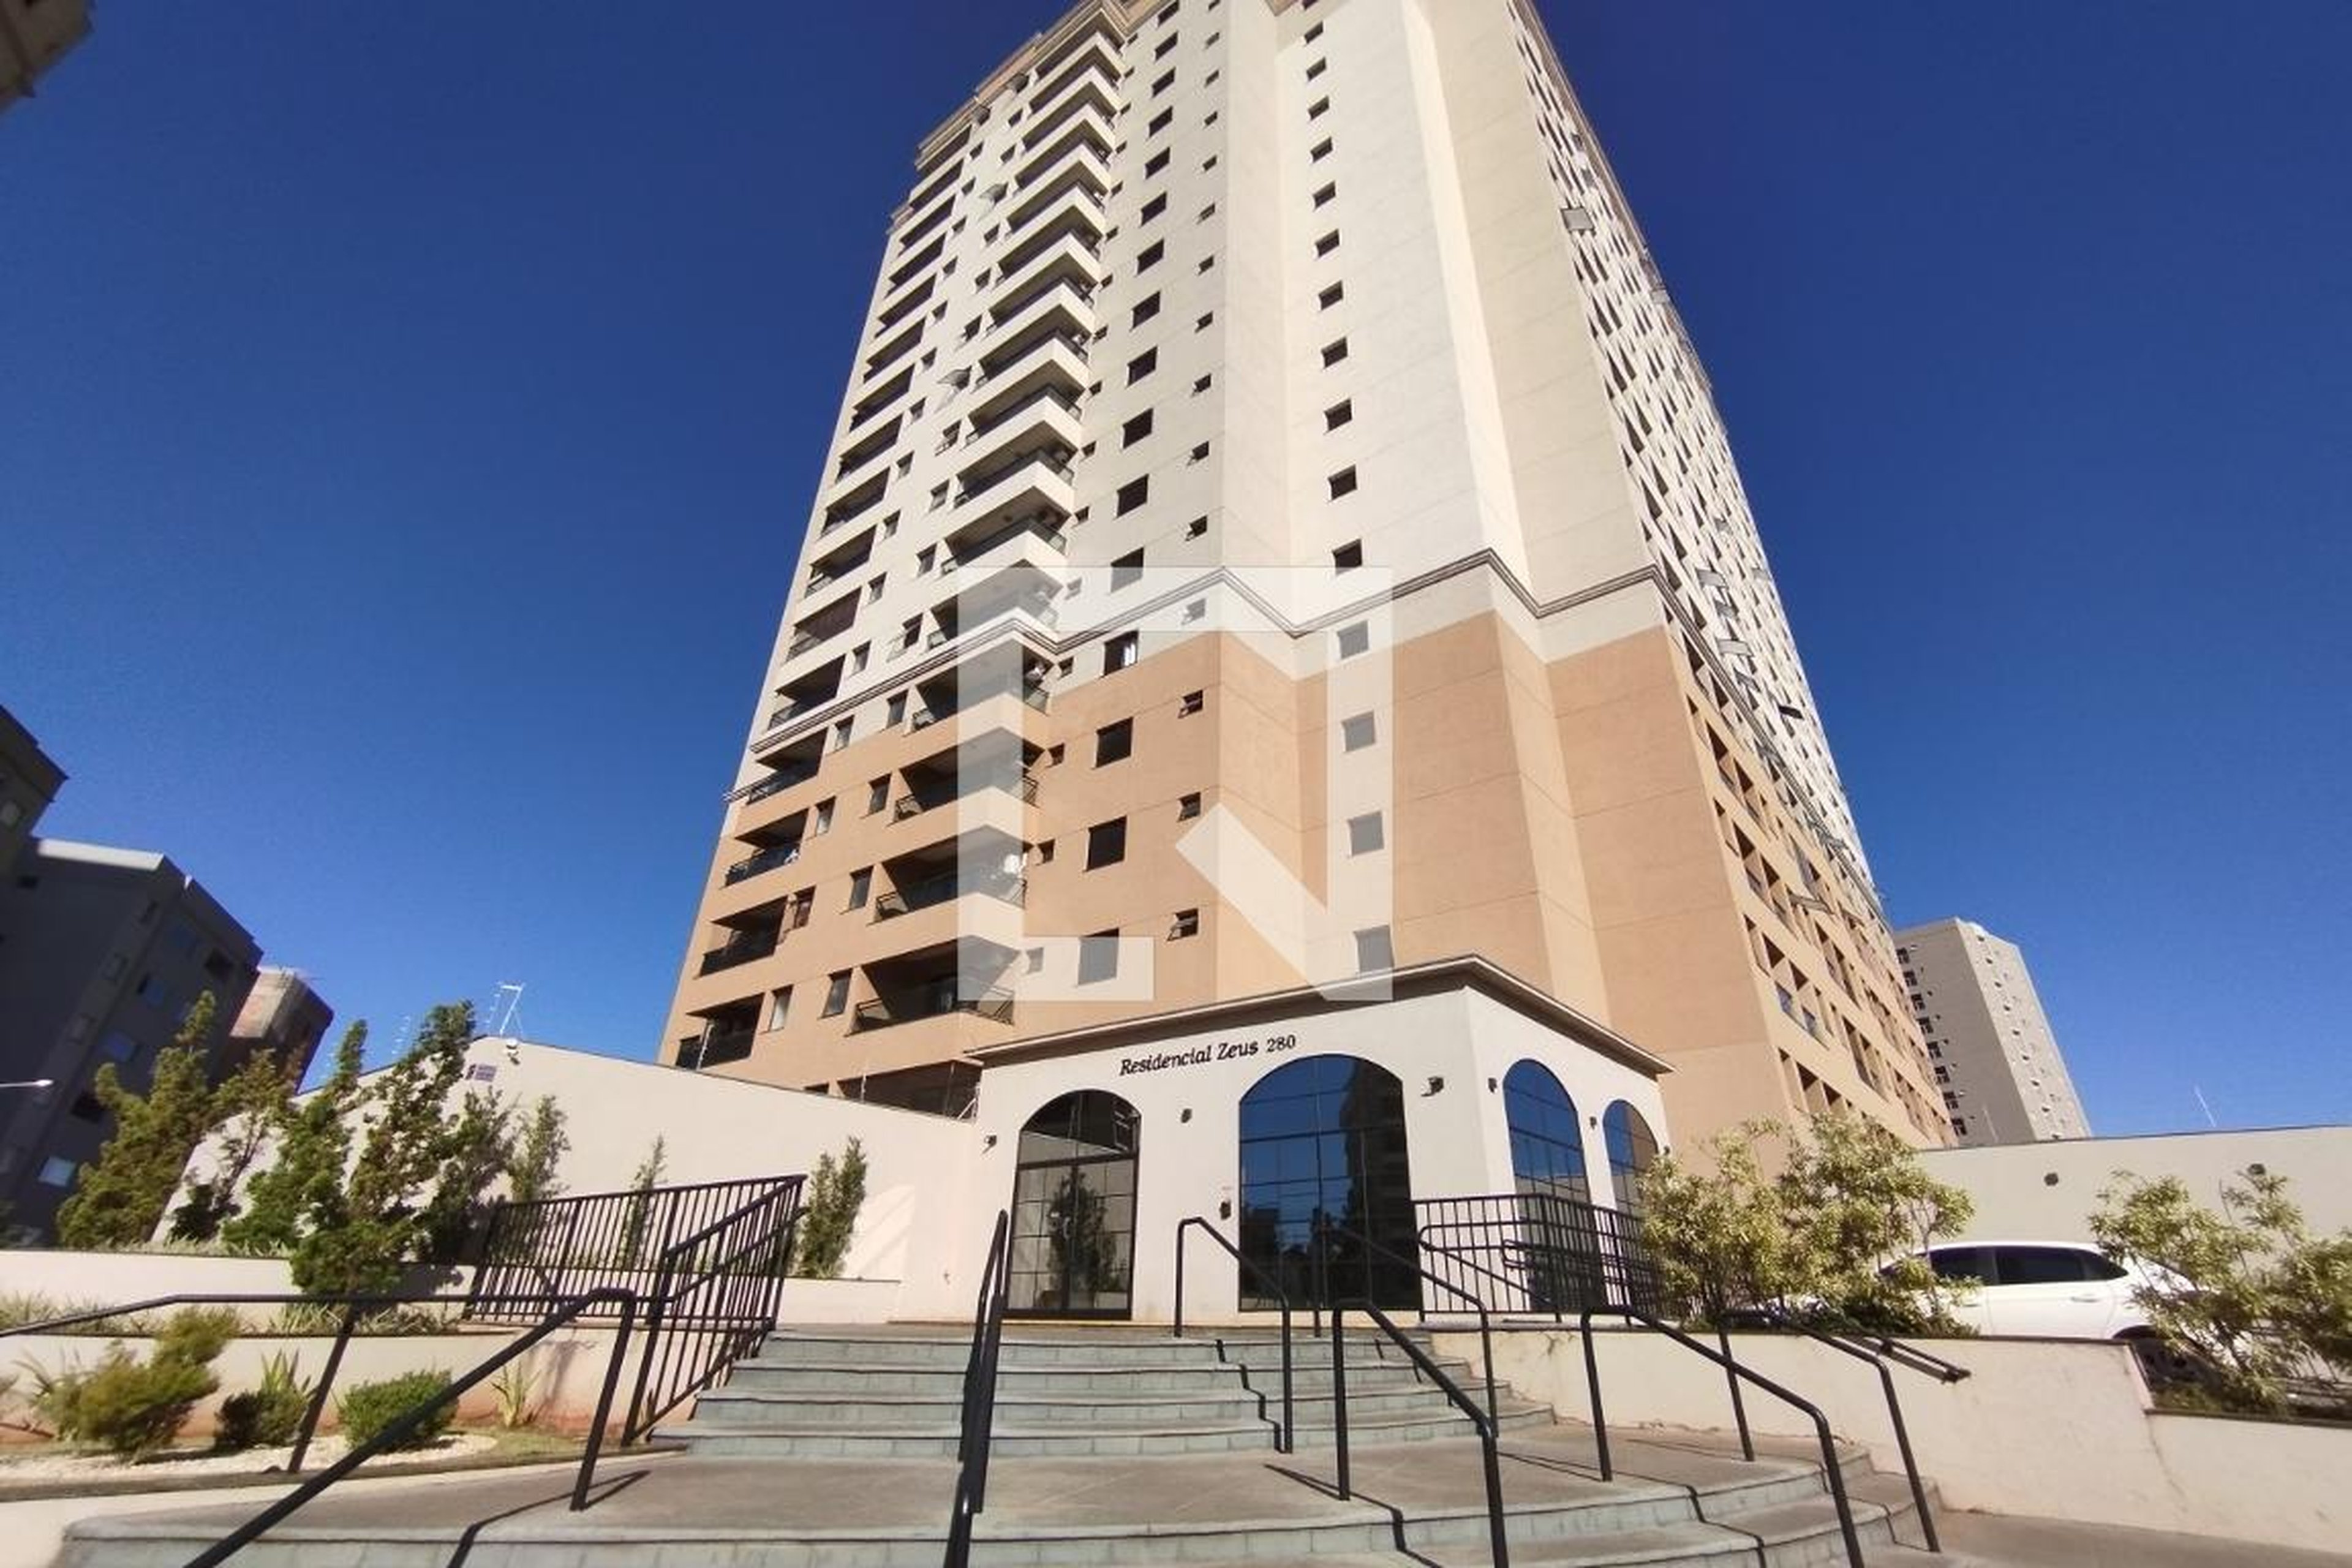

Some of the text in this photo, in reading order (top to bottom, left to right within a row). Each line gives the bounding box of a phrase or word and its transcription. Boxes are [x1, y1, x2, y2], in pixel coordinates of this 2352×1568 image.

[1120, 1034, 1296, 1076] Residencial Zeus 280
